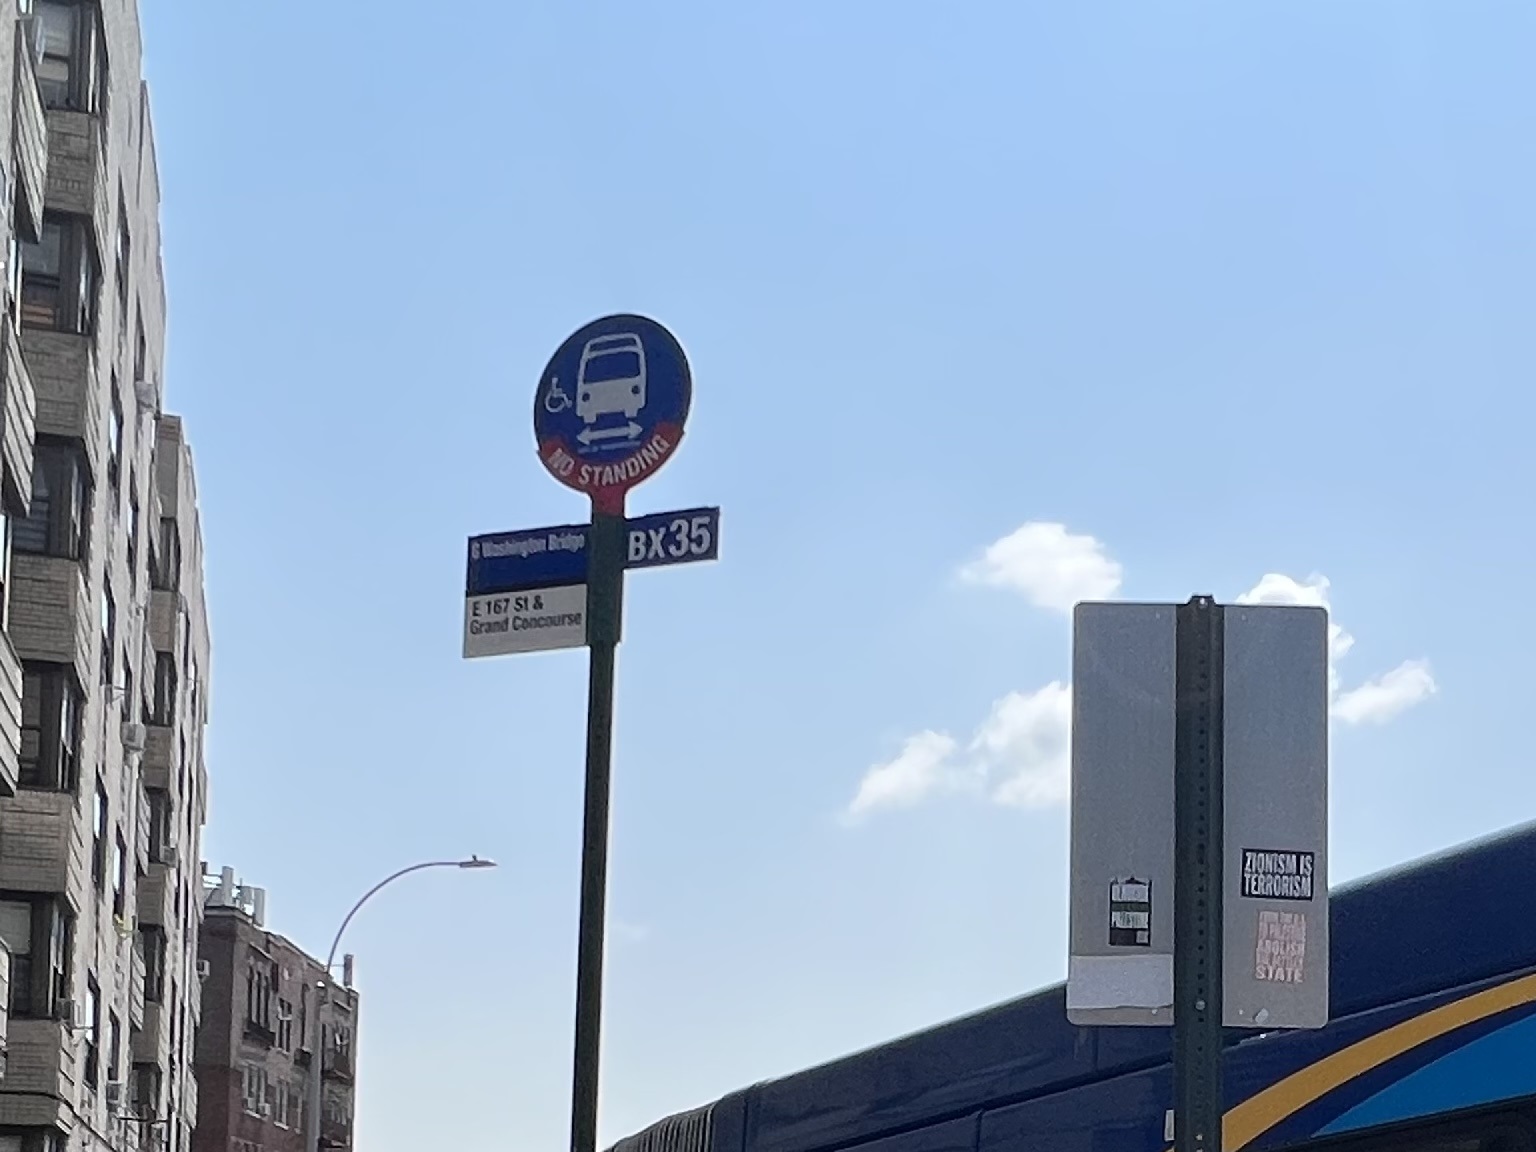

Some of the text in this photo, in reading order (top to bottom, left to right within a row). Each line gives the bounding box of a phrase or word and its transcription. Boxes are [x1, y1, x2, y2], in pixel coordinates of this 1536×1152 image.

[549, 434, 670, 486] NO STANDING
[548, 532, 585, 552] Bridge
[628, 516, 711, 561] BX35
[472, 595, 544, 617] E 167 St &
[470, 611, 582, 635] Grand Concourse
[1245, 852, 1313, 878] ZIONISM IS
[1244, 874, 1311, 897] TERRORISM
[1255, 965, 1304, 983] STATE
